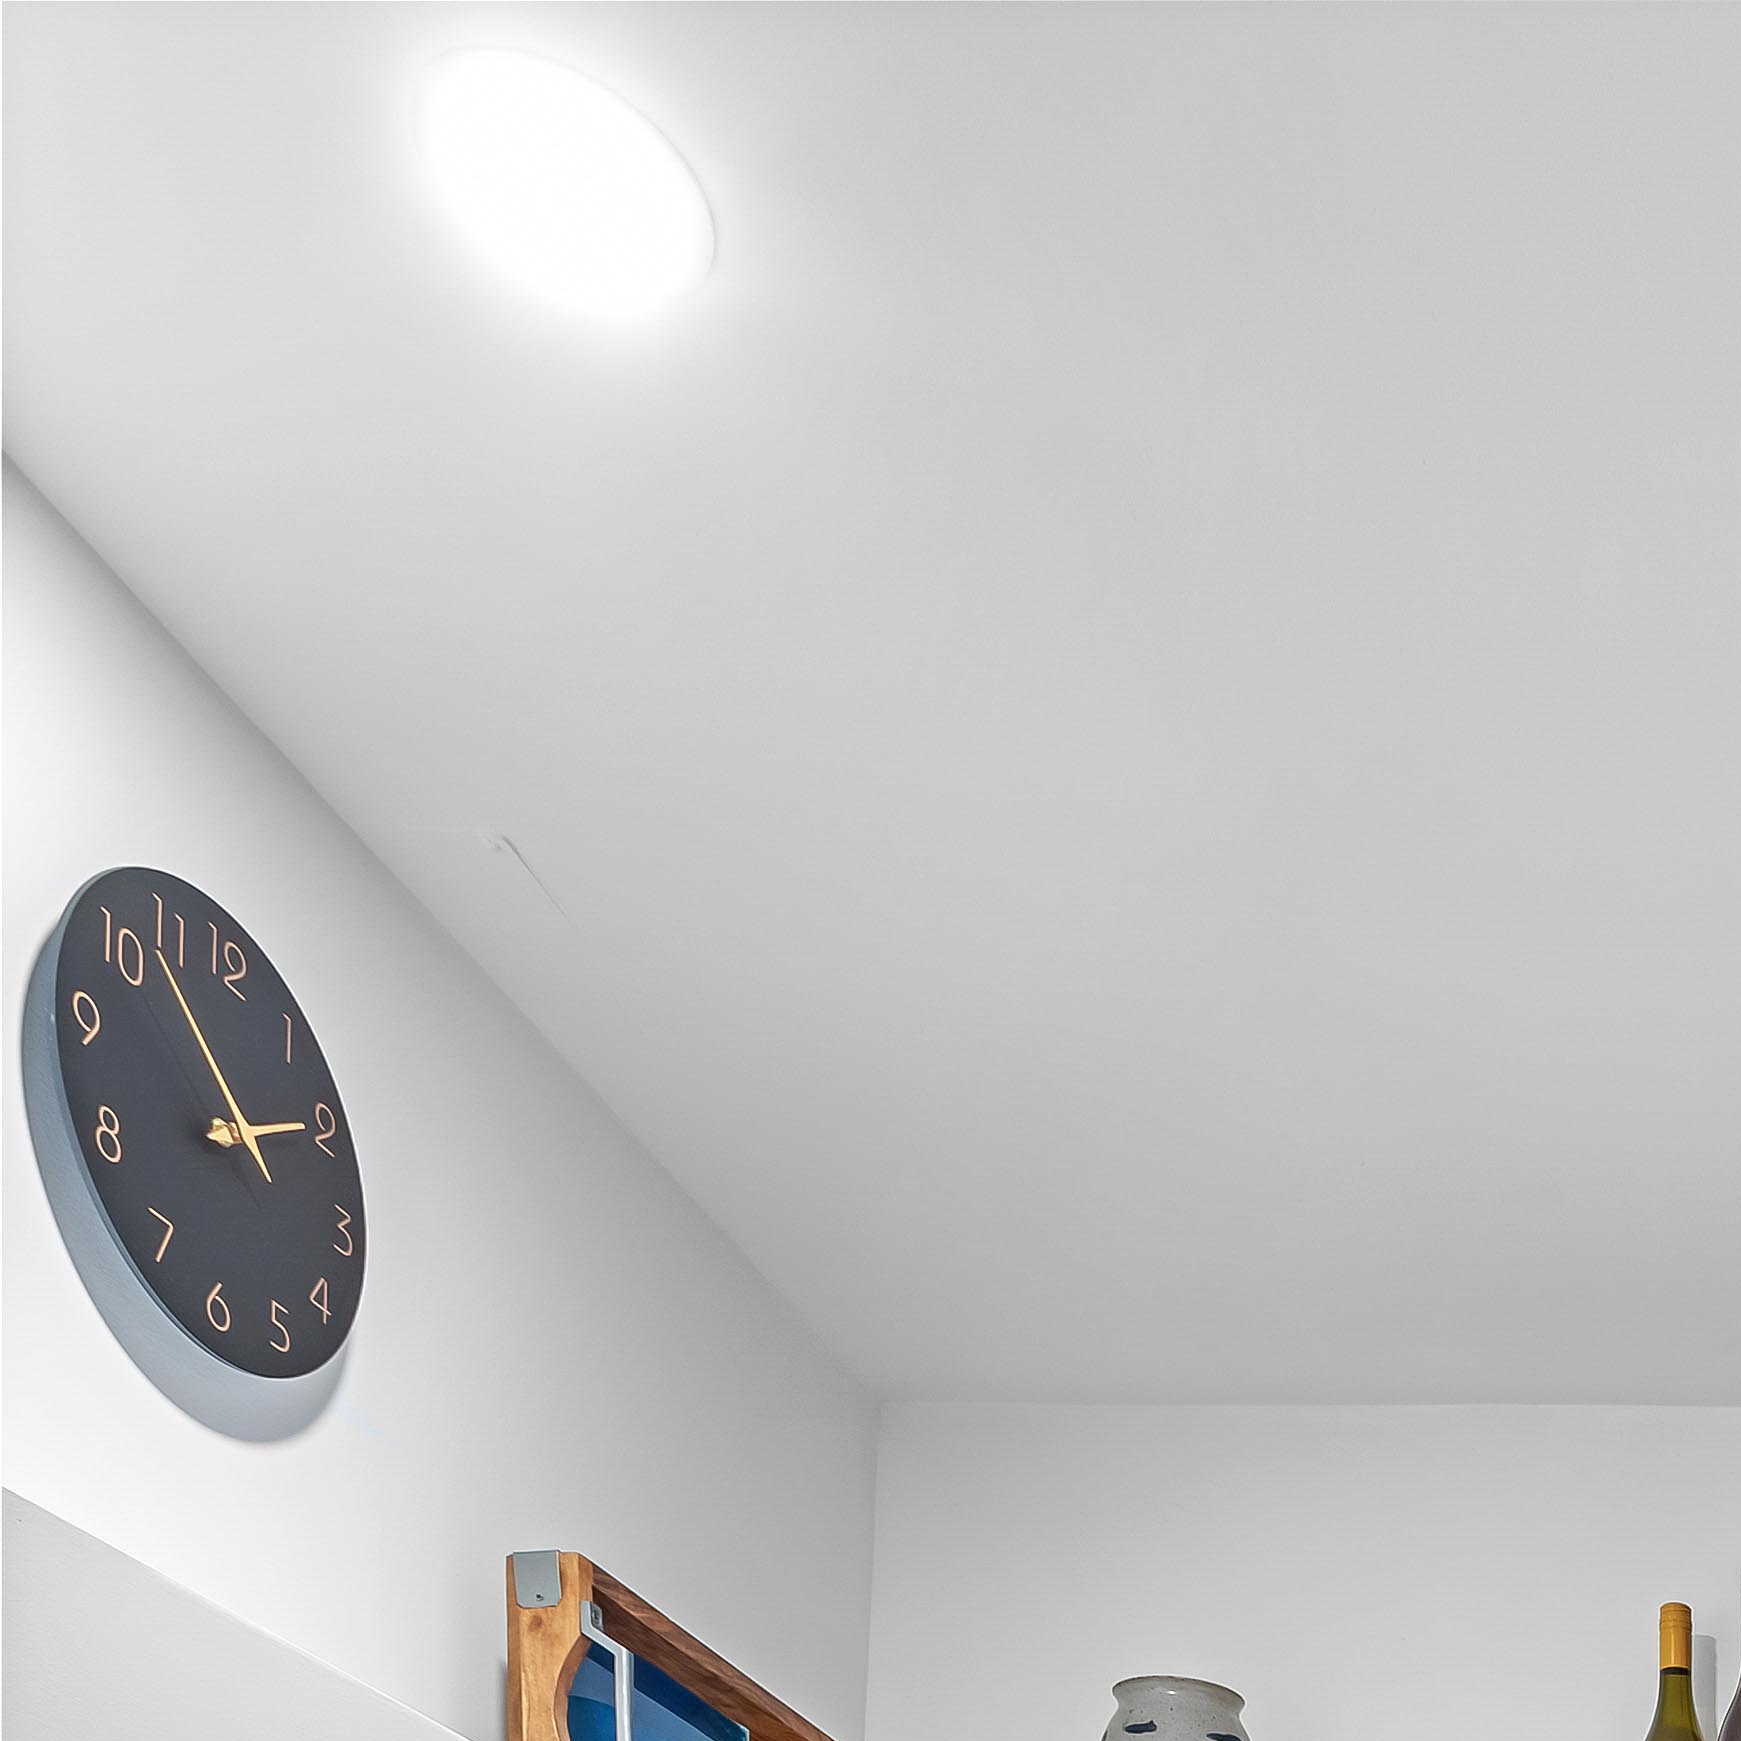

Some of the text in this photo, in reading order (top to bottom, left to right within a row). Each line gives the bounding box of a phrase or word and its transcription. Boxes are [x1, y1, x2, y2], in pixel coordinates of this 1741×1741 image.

[100, 905, 144, 987] 10
[151, 892, 185, 968] 11
[207, 920, 248, 1001] 12
[72, 990, 101, 1046] 9
[282, 1012, 292, 1064] 1
[95, 1104, 122, 1163] 8
[314, 1102, 337, 1158] 2
[147, 1207, 175, 1263] 7
[332, 1203, 353, 1257] 3
[206, 1281, 232, 1332] 6
[269, 1298, 290, 1353] 5
[309, 1276, 332, 1325] 4
